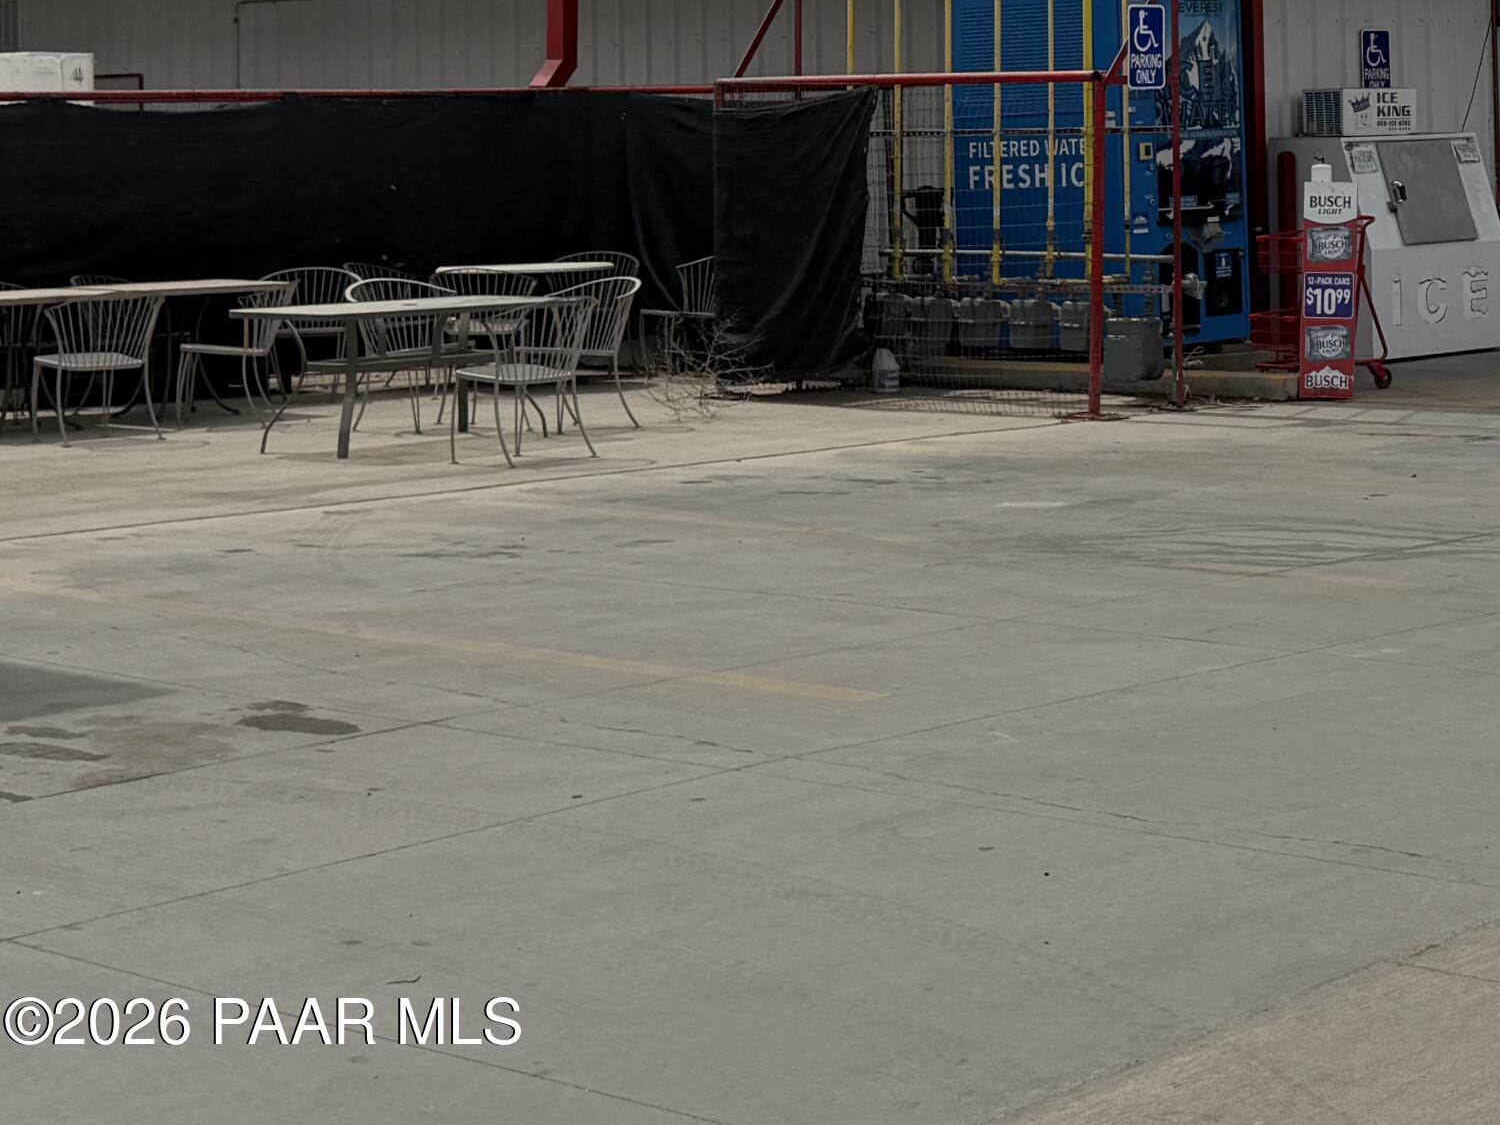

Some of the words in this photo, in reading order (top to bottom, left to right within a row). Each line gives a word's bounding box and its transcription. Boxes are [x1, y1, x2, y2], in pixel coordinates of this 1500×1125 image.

[1178, 2, 1224, 13] EVEREST
[1130, 53, 1162, 69] PARKING
[1135, 69, 1157, 84] ONLY
[1364, 67, 1390, 80] PARKING
[1376, 91, 1399, 104] ICE
[1376, 105, 1411, 117] KING
[1044, 137, 1085, 156] WATE
[968, 163, 1050, 190] FRESH
[1060, 161, 1085, 188] IC
[1309, 195, 1352, 209] BUSCH
[1317, 239, 1347, 251] BUSCH
[1306, 276, 1332, 285] 12-PACK
[1334, 276, 1351, 285] CANS
[1315, 338, 1345, 351] BUSCH
[1304, 375, 1349, 389] BUSCH
